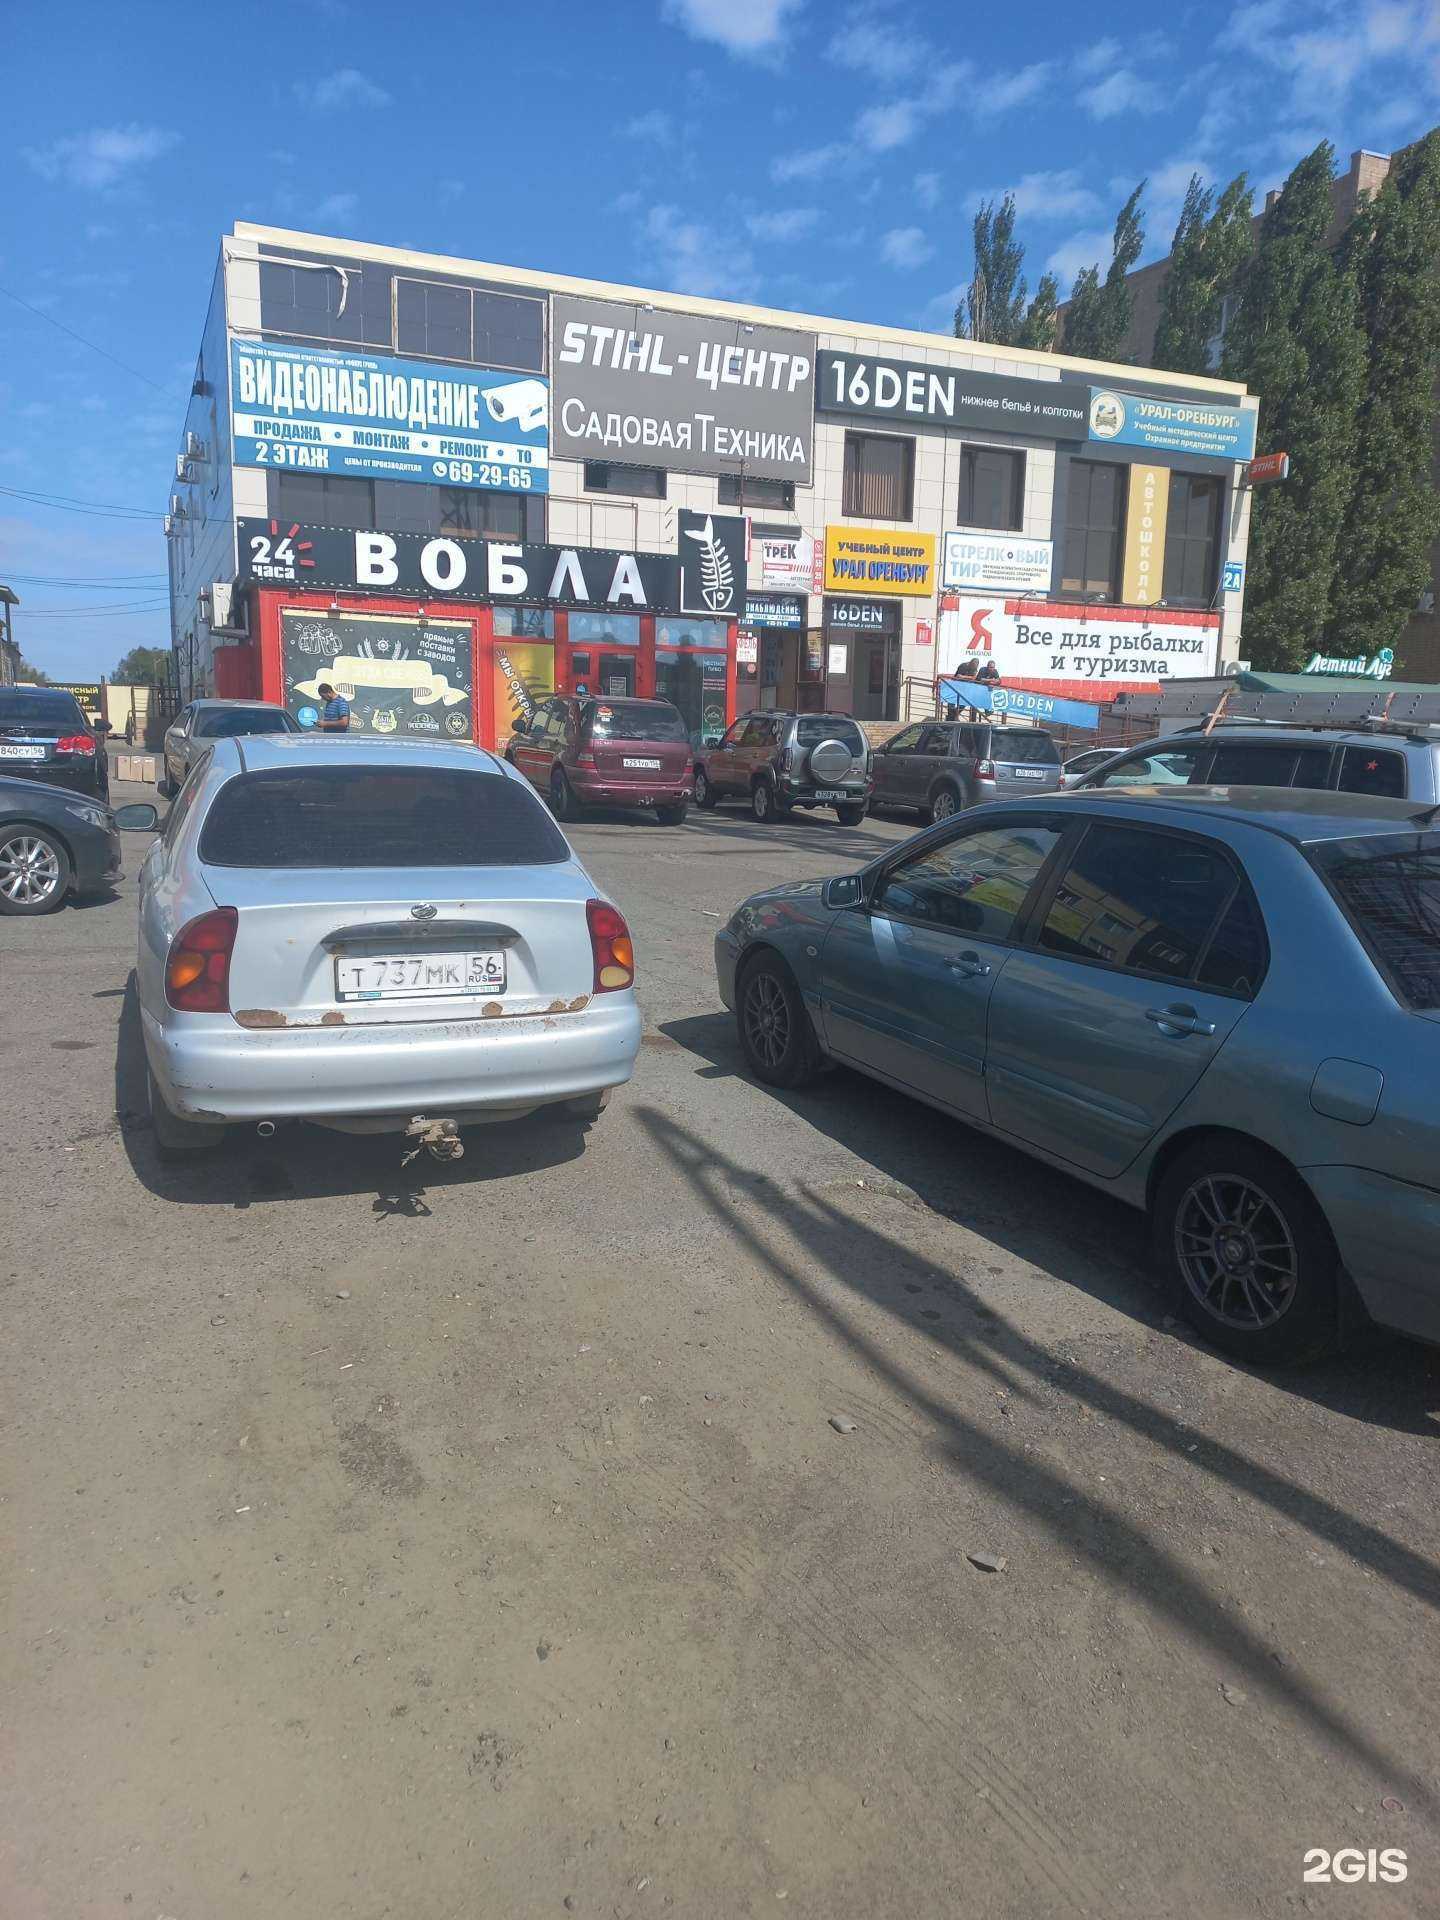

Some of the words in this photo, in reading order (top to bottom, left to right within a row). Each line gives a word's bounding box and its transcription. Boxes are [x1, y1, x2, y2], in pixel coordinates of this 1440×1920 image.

[240, 357, 479, 430] ВИДЕОНАБЛЮДЕНИЕ
[961, 395, 999, 409] нижнее
[1034, 405, 1040, 414] и
[1043, 406, 1084, 420] колготки
[254, 420, 322, 441] ПРОДАЖА
[353, 431, 410, 450] МОНТАЖ
[440, 441, 488, 459] РЕМОНТ
[517, 450, 532, 464] ТО
[1134, 421, 1167, 433] Учебный
[1218, 434, 1238, 443] центр
[1145, 433, 1180, 445] Охранное
[1180, 439, 1226, 450] предприятие
[255, 442, 270, 462] 2
[273, 444, 329, 469] ЭТАЖ
[449, 462, 532, 488] 69-29-65
[251, 536, 295, 565] 24
[838, 541, 891, 556] УЧЕБНЫЙ
[892, 546, 925, 558] ЦЕНТР
[833, 557, 867, 580] УРАЛ
[869, 561, 930, 584] ОРЕНБУРГ
[950, 560, 981, 578] ТИР
[1015, 624, 1053, 646] Все
[1060, 633, 1101, 656] для
[1109, 631, 1204, 655] рыбалки
[1051, 656, 1065, 670] и
[1074, 657, 1169, 679] туризма
[1306, 652, 1367, 674] Летний
[1366, 657, 1393, 680] Луг
[472, 956, 497, 975] 56
[468, 974, 488, 983] RUS
